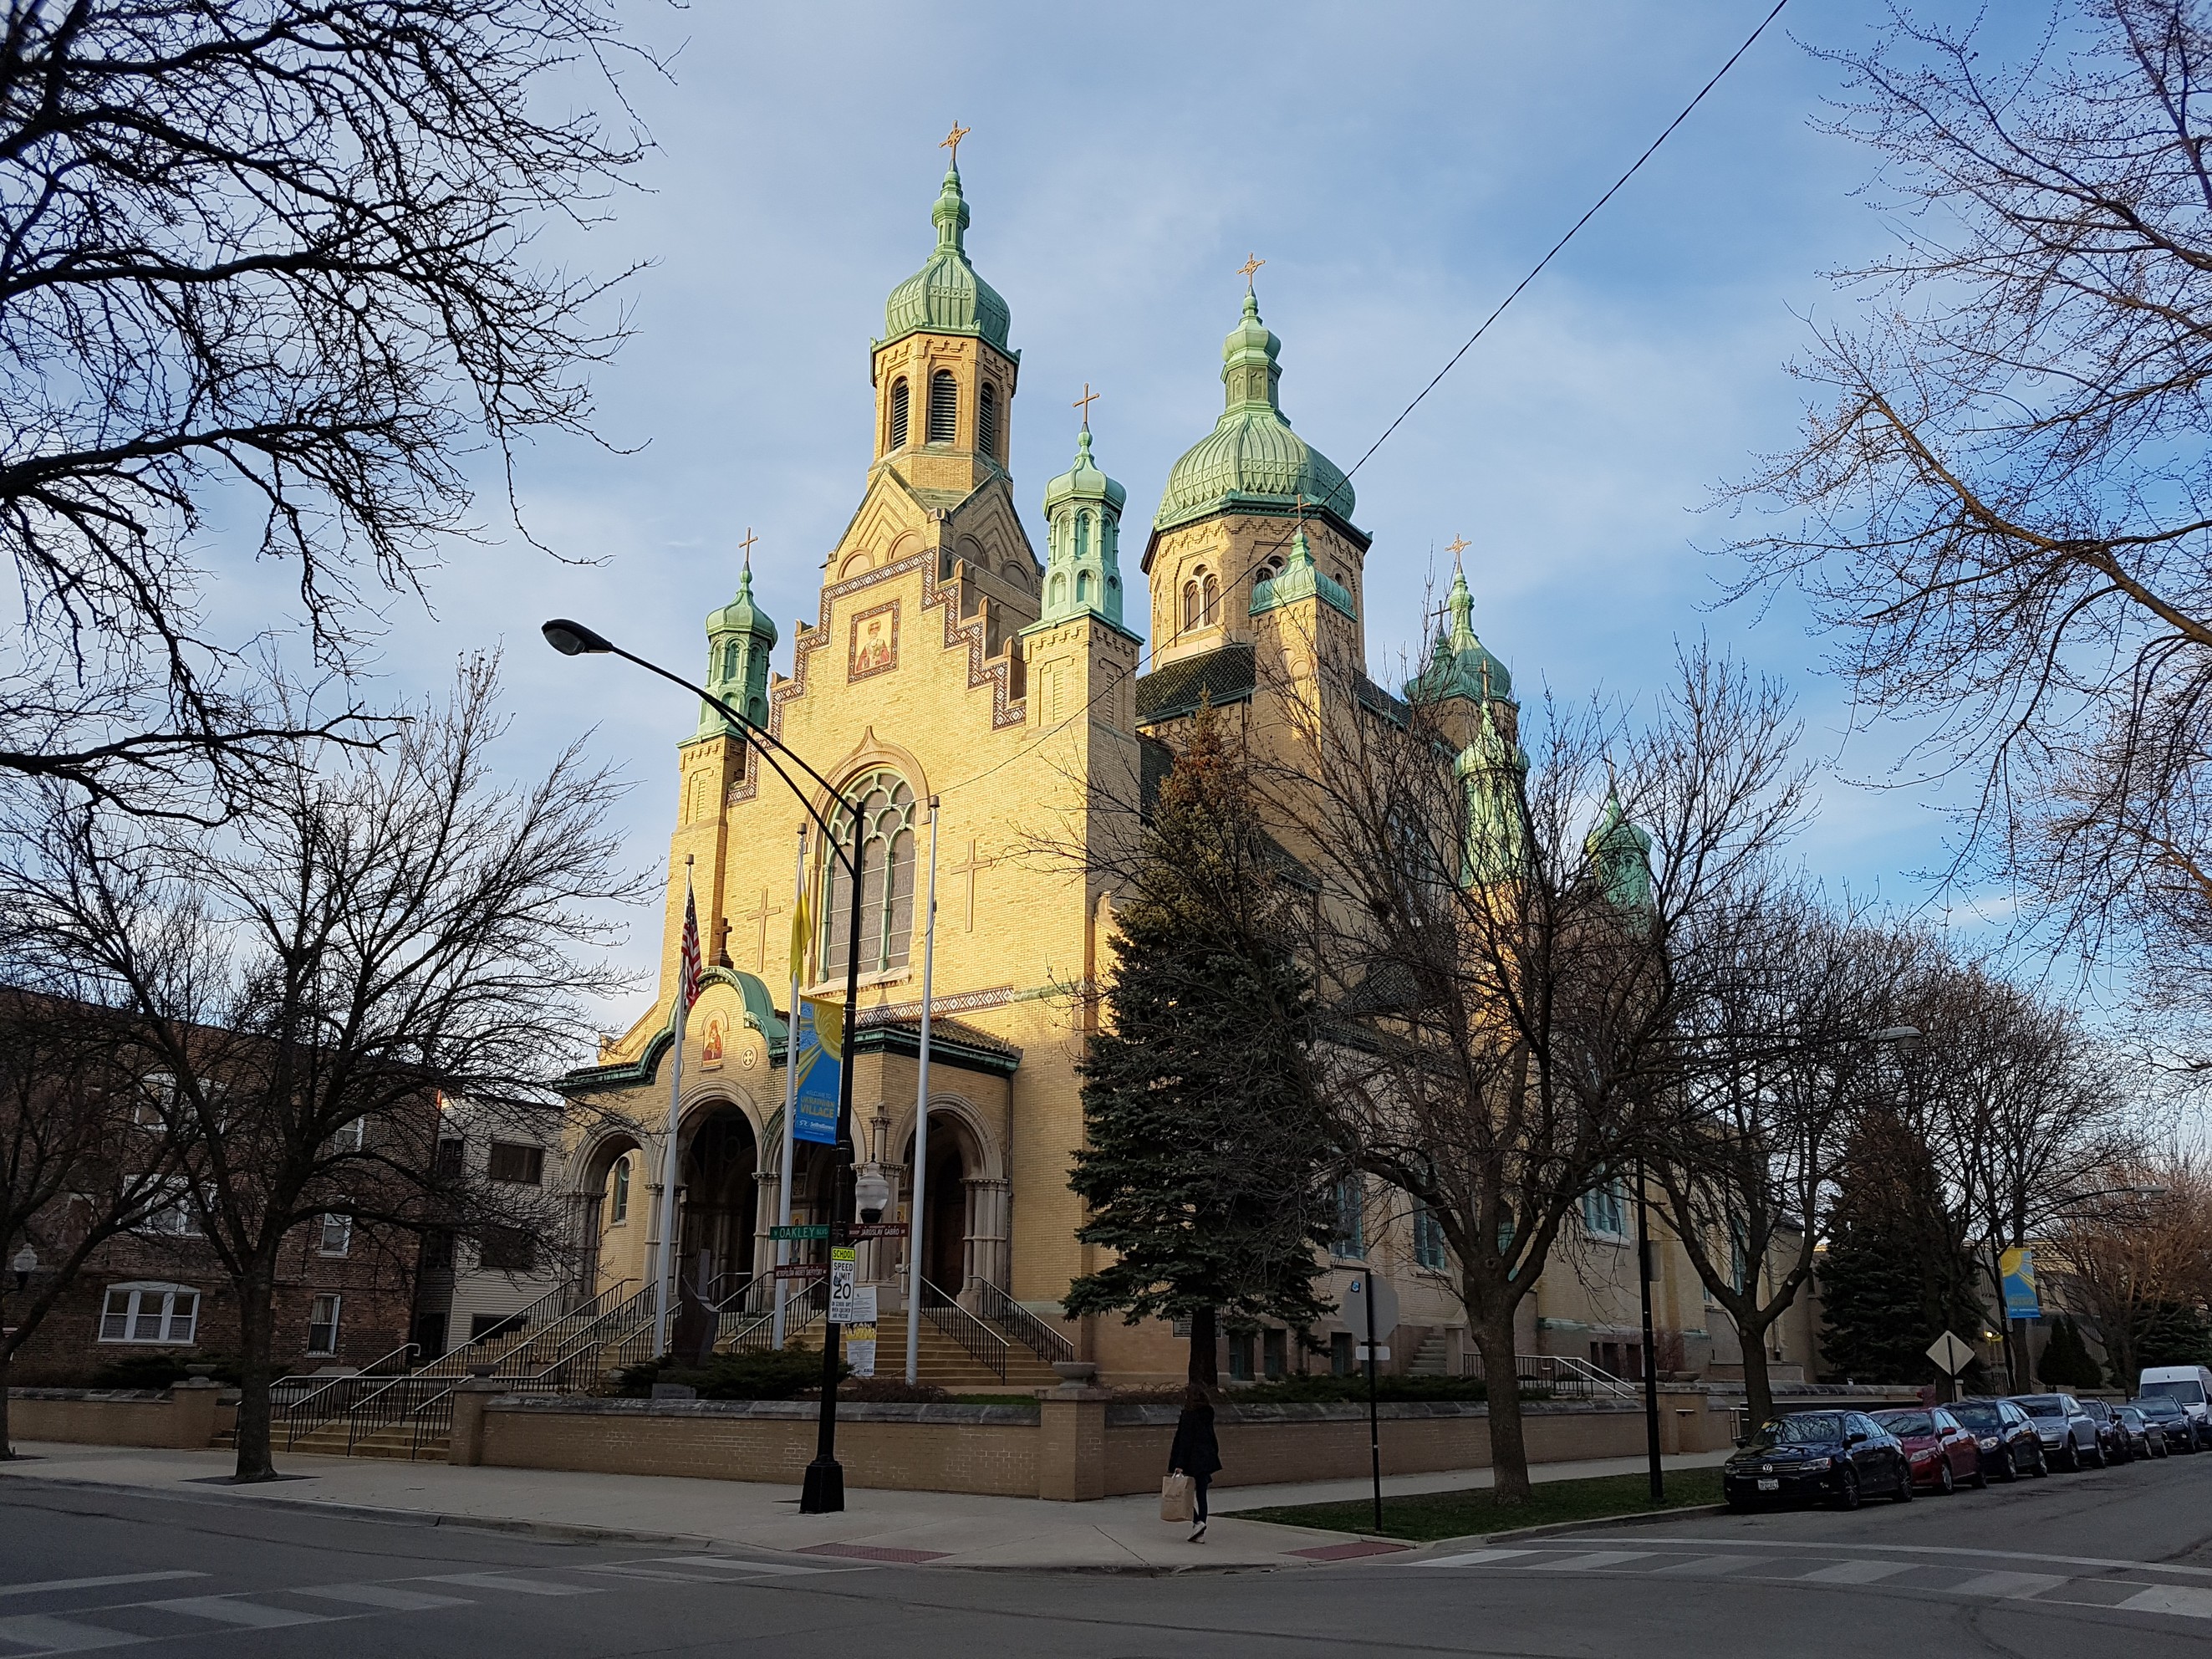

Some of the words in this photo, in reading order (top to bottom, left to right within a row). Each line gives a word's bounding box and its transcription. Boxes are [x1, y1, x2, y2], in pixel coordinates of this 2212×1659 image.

[801, 1104, 834, 1119] VILLAGE
[779, 1227, 815, 1238] OAKLEY
[884, 1228, 900, 1236] GABRO
[833, 1249, 854, 1259] SCHOOL
[833, 1262, 854, 1272] SPEED
[833, 1283, 852, 1299] 20
